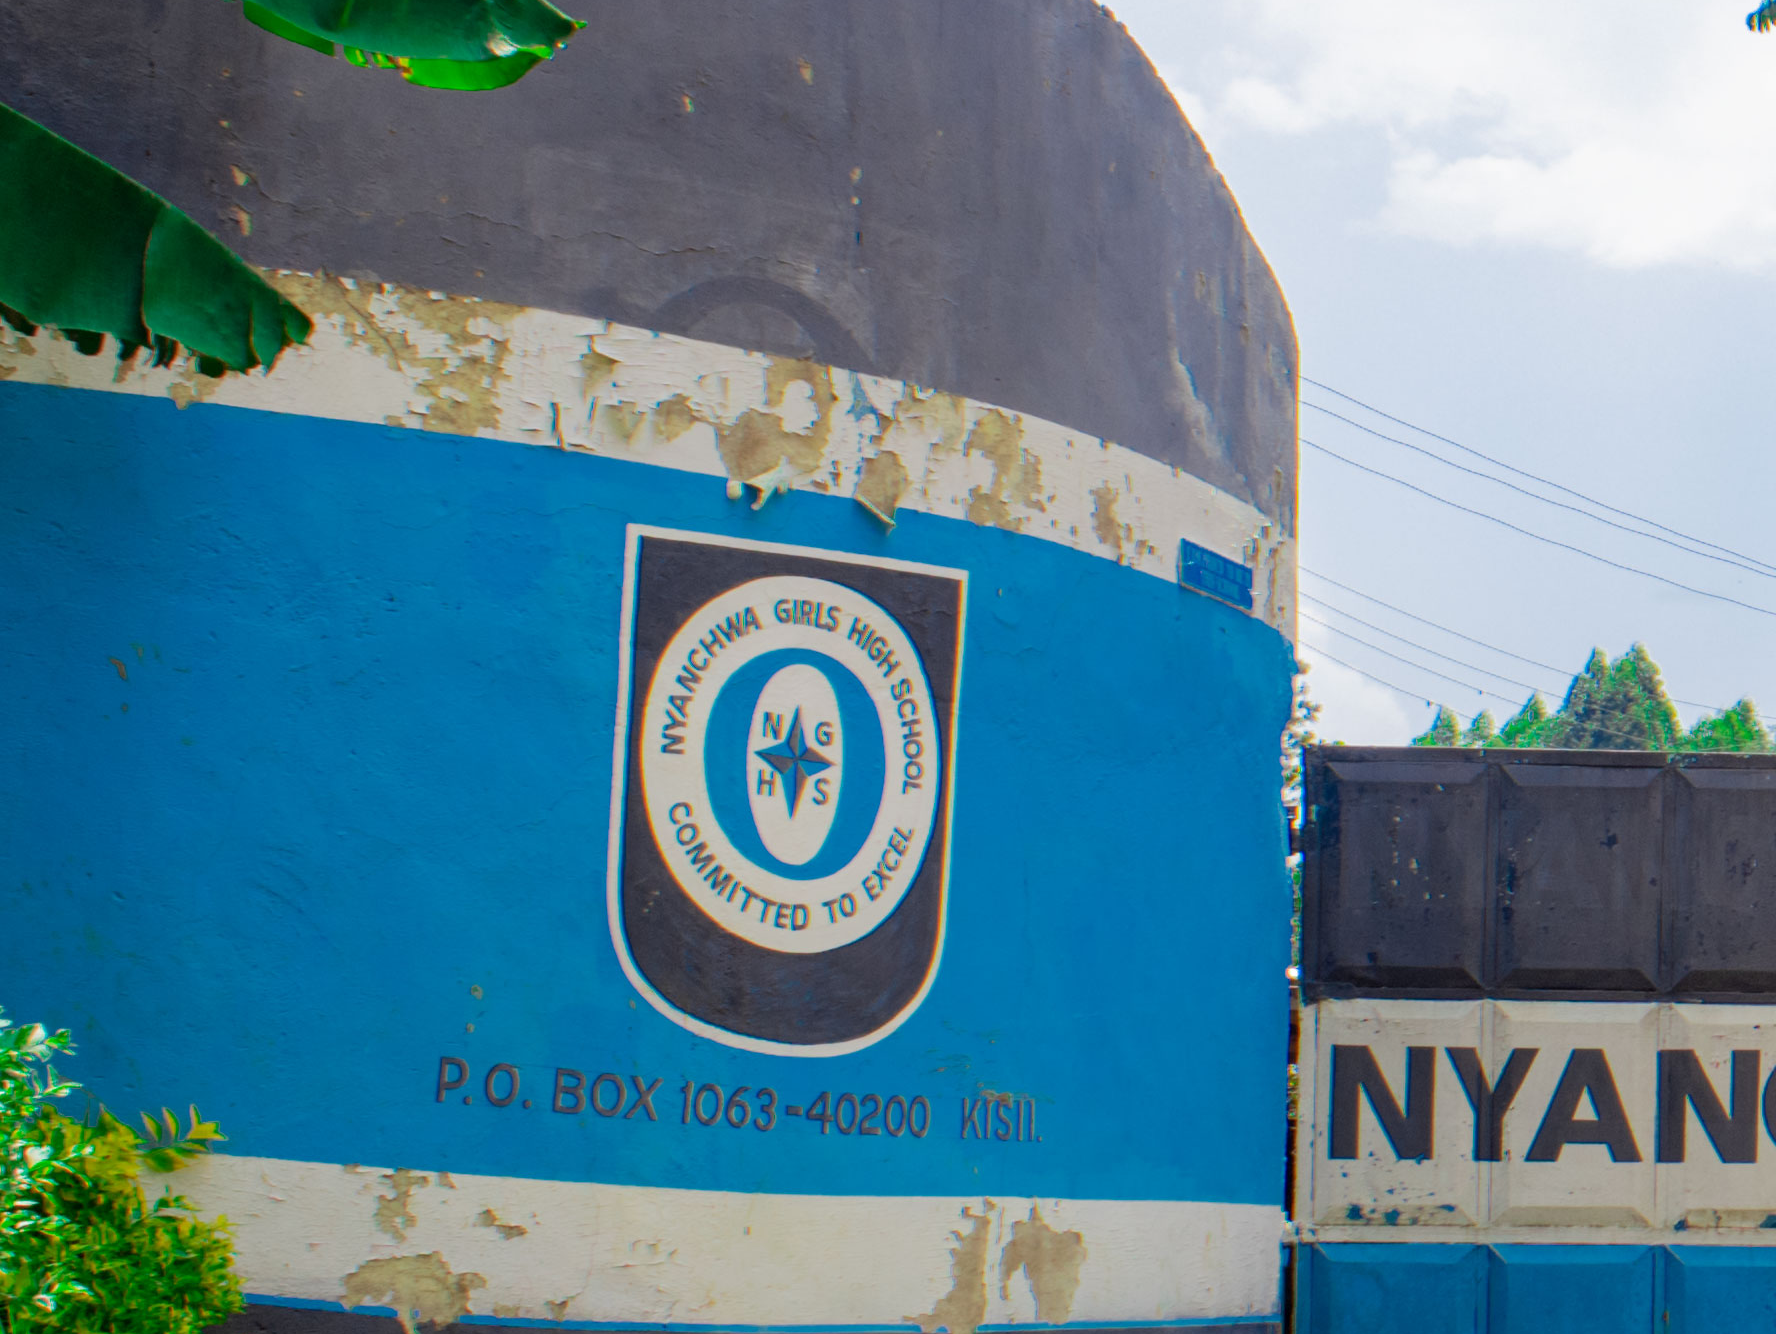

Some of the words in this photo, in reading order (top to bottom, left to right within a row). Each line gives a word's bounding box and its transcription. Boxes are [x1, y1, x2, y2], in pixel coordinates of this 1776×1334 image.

[662, 606, 762, 754] NYANCHWA
[774, 599, 842, 633] GIRLS
[848, 620, 900, 679] HIGH
[892, 679, 923, 794] SCHOOL
[763, 711, 783, 738] N
[815, 722, 833, 747] G
[757, 771, 775, 795] H
[812, 777, 829, 806] S
[668, 802, 809, 930] COMMITTED
[821, 894, 857, 925] TO
[863, 825, 914, 901] EXCEL
[553, 1067, 664, 1122] BOX
[681, 1080, 931, 1139] 1063-40200
[961, 1097, 1043, 1143] KISII.
